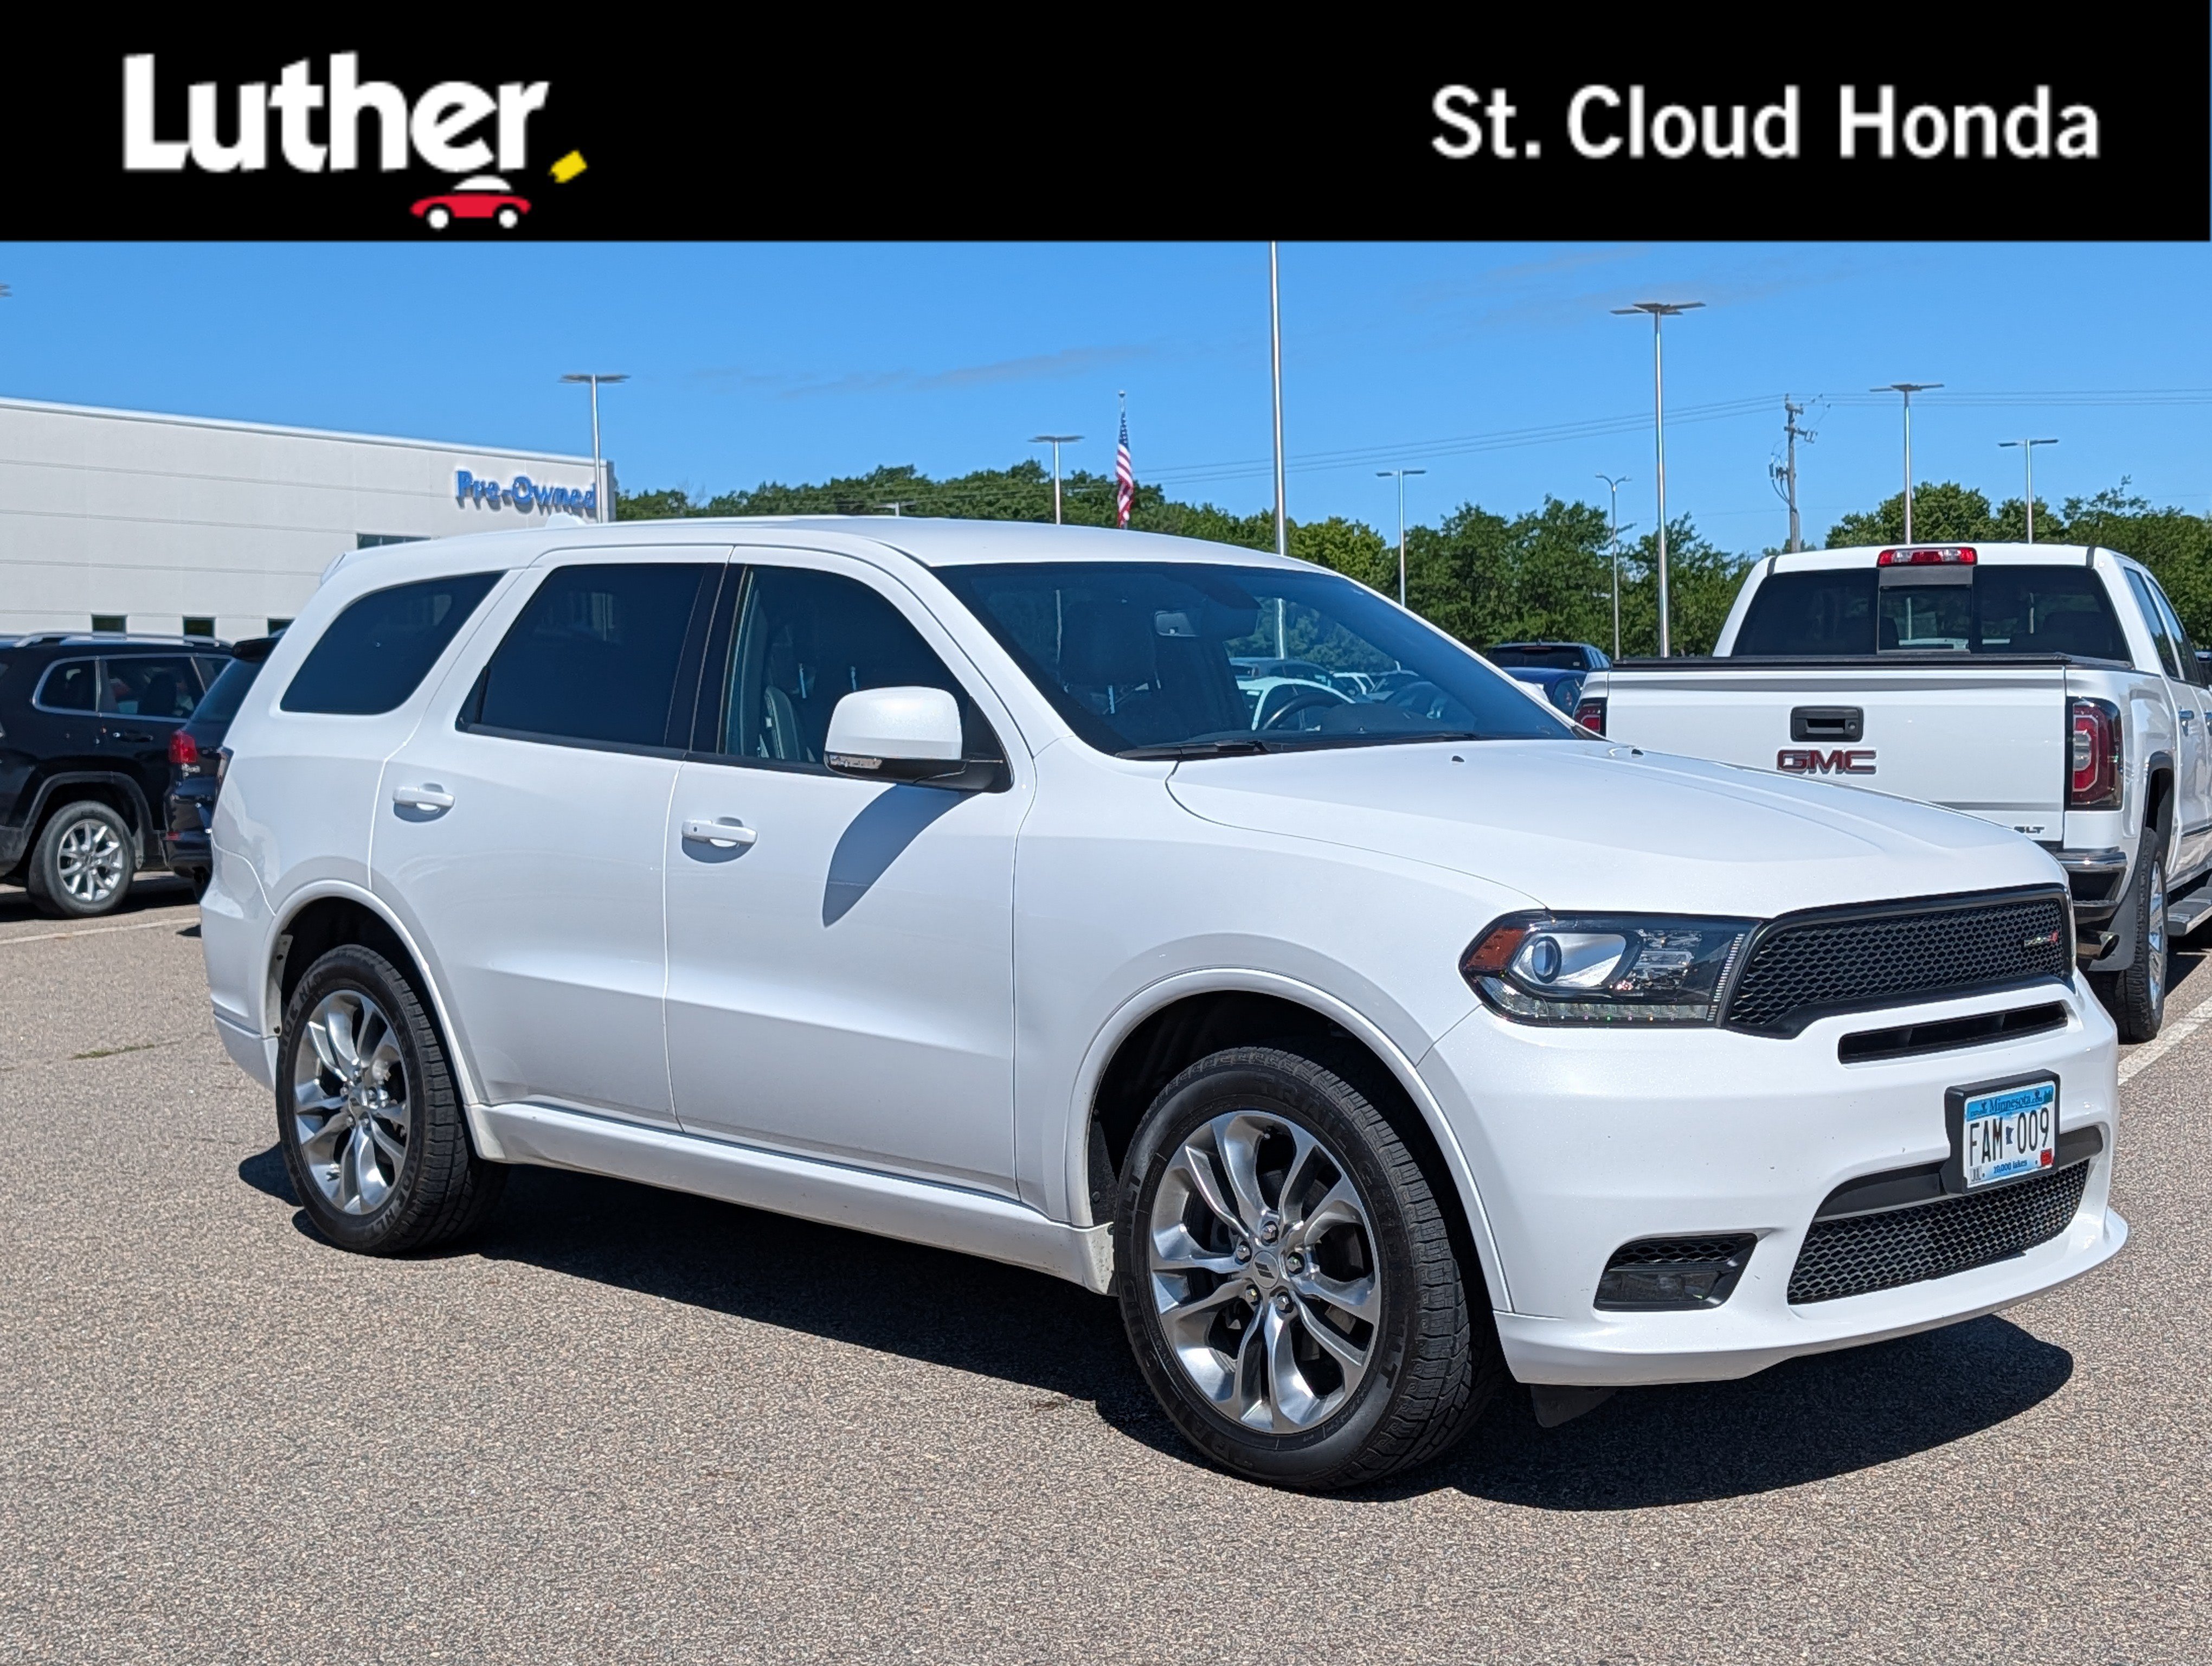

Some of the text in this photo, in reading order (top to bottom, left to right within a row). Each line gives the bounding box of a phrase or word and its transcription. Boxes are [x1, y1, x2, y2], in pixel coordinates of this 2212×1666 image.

[456, 470, 596, 509] Pre-Owned
[1777, 749, 1877, 775] GMC
[1970, 1107, 2049, 1167] FAM 009
